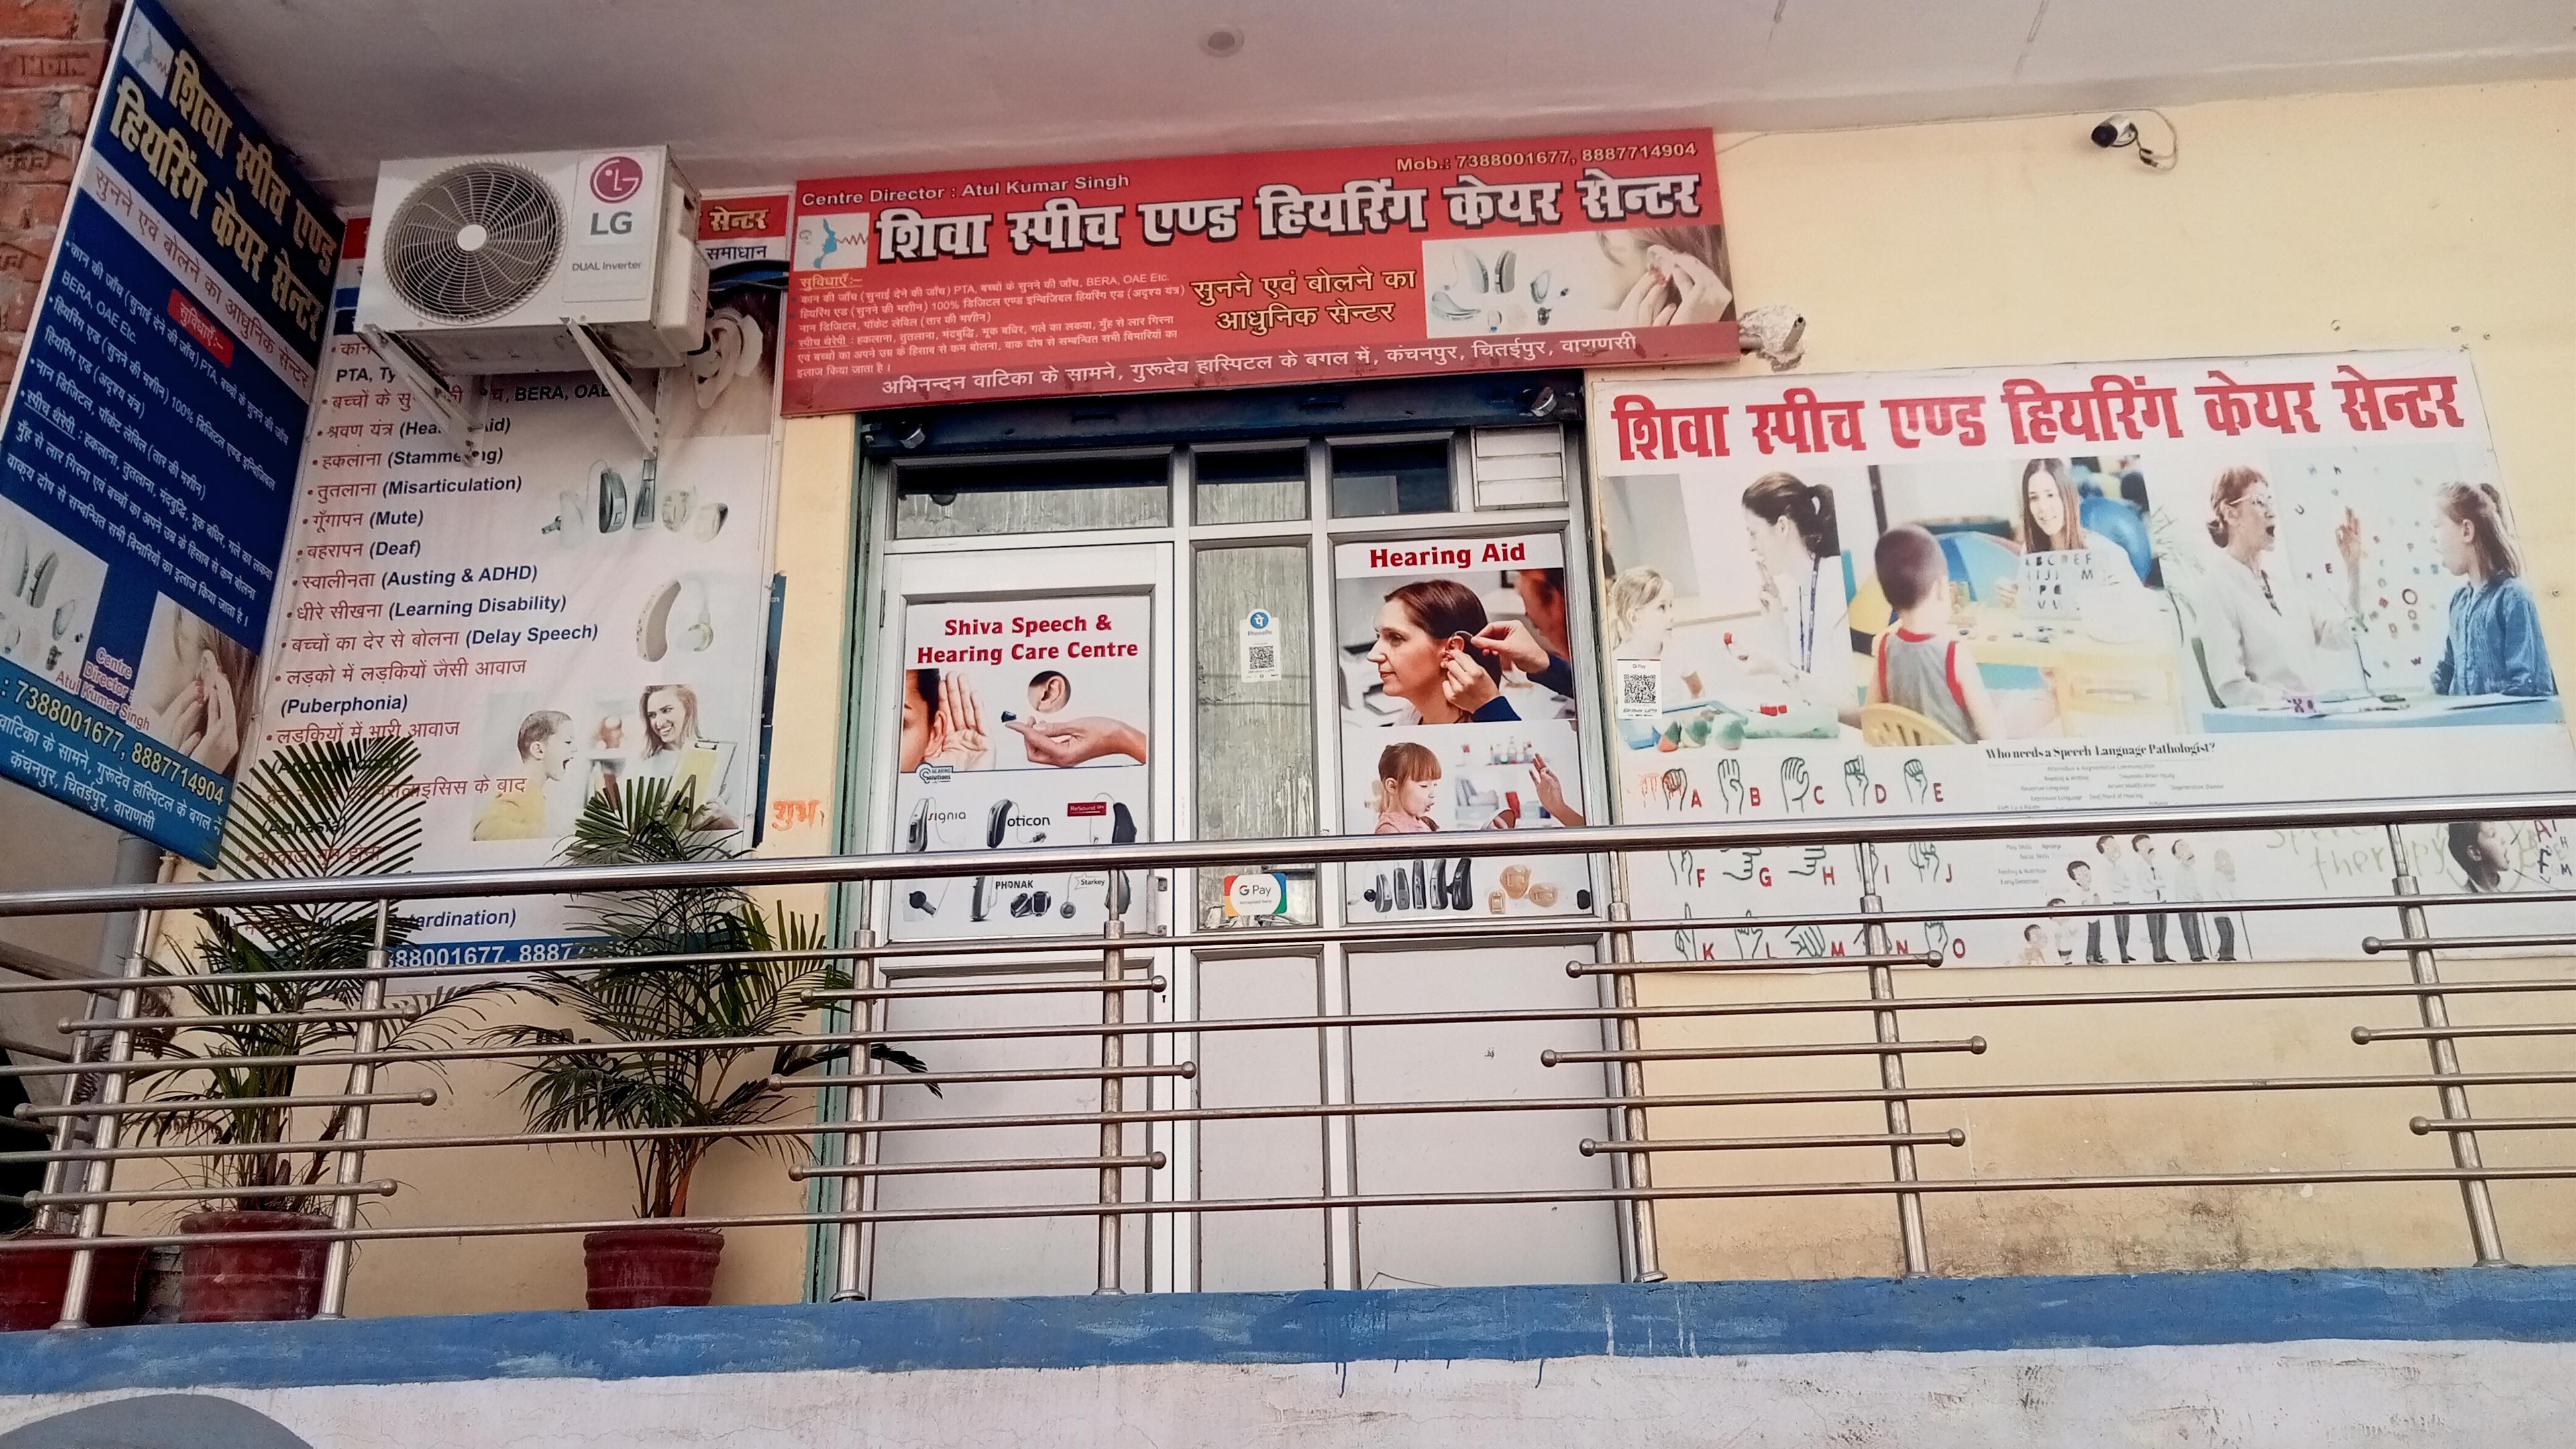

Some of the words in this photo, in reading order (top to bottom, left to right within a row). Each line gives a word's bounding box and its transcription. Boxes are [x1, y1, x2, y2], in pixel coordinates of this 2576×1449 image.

[169, 49, 233, 160] शिवा
[235, 132, 290, 225] स्पीच
[294, 200, 336, 277] एण्ड
[1456, 149, 1576, 168] 7388001677,
[1582, 143, 1697, 162] 8887714904
[802, 190, 863, 206] Centre
[871, 184, 945, 201] Director
[963, 182, 999, 197] Atul
[1007, 178, 1068, 194] Kumar
[1075, 174, 1129, 193] Singh
[110, 75, 208, 220] हियरिंग
[212, 186, 268, 282] केयर
[272, 248, 325, 341] सेन्टर
[710, 205, 770, 231] सेन्टर
[876, 207, 994, 264] शिवा
[1006, 197, 1125, 252] स्पीच
[1138, 197, 1242, 246] एण्ड
[1256, 177, 1428, 237] हियरिंग
[1444, 169, 1562, 224] केयर
[1578, 168, 1701, 220] सेन्टर
[590, 211, 633, 235] LG
[707, 244, 767, 261] समाधान
[572, 262, 600, 271] DUAL
[602, 260, 641, 271] Inverter
[95, 170, 134, 217] सुनने
[139, 209, 162, 242] एवं
[163, 233, 202, 288] बोलने
[205, 275, 225, 303] का
[225, 297, 275, 354] आधुनिक
[278, 348, 311, 388] सेन्टर
[1087, 276, 1120, 286] BERA,
[1124, 274, 1146, 284] OAE
[1150, 274, 1169, 282] Etc.
[1192, 273, 1252, 307] सुनने
[1263, 276, 1296, 299] एवं
[1307, 265, 1373, 295] बोलने
[1385, 270, 1416, 289] का
[62, 270, 93, 309] BERA,
[97, 301, 117, 328] OAE
[932, 301, 959, 310] 100%
[1216, 305, 1316, 335] आधुनिक
[1329, 301, 1396, 324] सेन्टर
[336, 368, 372, 383] PTA,
[882, 367, 965, 395] अभिनन्दन
[974, 364, 1033, 388] वाटिका
[1040, 366, 1058, 384] के
[1066, 360, 1123, 382] सामने,
[1195, 354, 1272, 376] हास्पिटल
[1280, 347, 1297, 368] के
[1306, 349, 1347, 366] बगल
[332, 389, 369, 409] बच्चों
[376, 388, 390, 407] के
[515, 386, 569, 401] BERA,
[1611, 394, 1730, 461] शिवा
[1746, 387, 1866, 455] स्पीच
[1880, 395, 1987, 448] एण्ड
[2000, 374, 2184, 445] हियरिंग
[2194, 370, 2320, 436] केयर
[2330, 364, 2465, 431] सेन्टर
[327, 424, 363, 438] श्रवण
[371, 420, 394, 437] यंत्र
[323, 453, 381, 469] हकलाना
[317, 483, 378, 504] तुतलाना
[382, 476, 522, 498] (Misarticulation)
[313, 510, 364, 533] गूँगापन
[370, 510, 424, 529] (Mute)
[307, 544, 364, 559] बहरापन
[370, 541, 421, 559] (Deaf)
[1370, 547, 1472, 569] Hearing
[1481, 542, 1525, 564] Aid
[302, 570, 376, 589] स्वालीनता
[382, 570, 455, 591] (Austing
[462, 568, 474, 583] &
[479, 565, 537, 583] ADHD)
[297, 603, 324, 622] धीरे
[331, 600, 382, 619] सीखना
[389, 601, 472, 620] (Learning
[478, 595, 567, 614] Disability)
[945, 619, 1003, 636] Shiva
[1012, 616, 1087, 637] Speech
[1096, 614, 1112, 631] &
[292, 633, 330, 652] बच्चों
[337, 635, 356, 651] का
[363, 630, 385, 649] देर
[391, 629, 406, 648] से
[412, 629, 459, 648] बोलना
[466, 628, 522, 648] (Delay
[527, 625, 598, 643] Speech)
[96, 647, 133, 679] Centre
[918, 647, 1003, 665] Hearing
[1011, 643, 1059, 659] Care
[1067, 641, 1139, 658] Centre
[83, 661, 129, 696] Director
[342, 658, 356, 682] में
[361, 660, 427, 685] लड़कियों
[433, 656, 468, 679] जैसी
[475, 659, 527, 676] आवाज
[56, 669, 79, 692] Atul
[80, 680, 119, 714] Kumar
[119, 706, 150, 731] Singh
[281, 694, 407, 717] (Puberphonia)
[350, 720, 362, 738] में
[408, 721, 460, 738] आवाज
[15, 680, 125, 761] 7388001677,
[131, 742, 225, 806] 8887714904
[1986, 747, 2011, 759] Who
[2053, 745, 2092, 759] Speech
[2096, 745, 2147, 757] Language
[2149, 743, 2215, 757] Pathologist?
[42, 734, 55, 753] के
[176, 798, 187, 818] के
[474, 775, 490, 794] के
[496, 777, 527, 794] बाद
[1690, 789, 1702, 808] A
[1750, 787, 1761, 806] B
[1813, 786, 1824, 804] C
[1876, 784, 1886, 804] D
[1934, 783, 1943, 802] E
[114, 799, 156, 833] वाराणसी
[928, 811, 966, 824] signia
[1007, 815, 1051, 827] oticon
[996, 879, 1034, 890] PHONAK
[1081, 878, 1105, 888] Starkey
[1697, 868, 1705, 888] F
[1759, 867, 1772, 887] G
[1822, 867, 1835, 885] H
[1252, 885, 1271, 897] Pay
[1953, 938, 1966, 958] O
